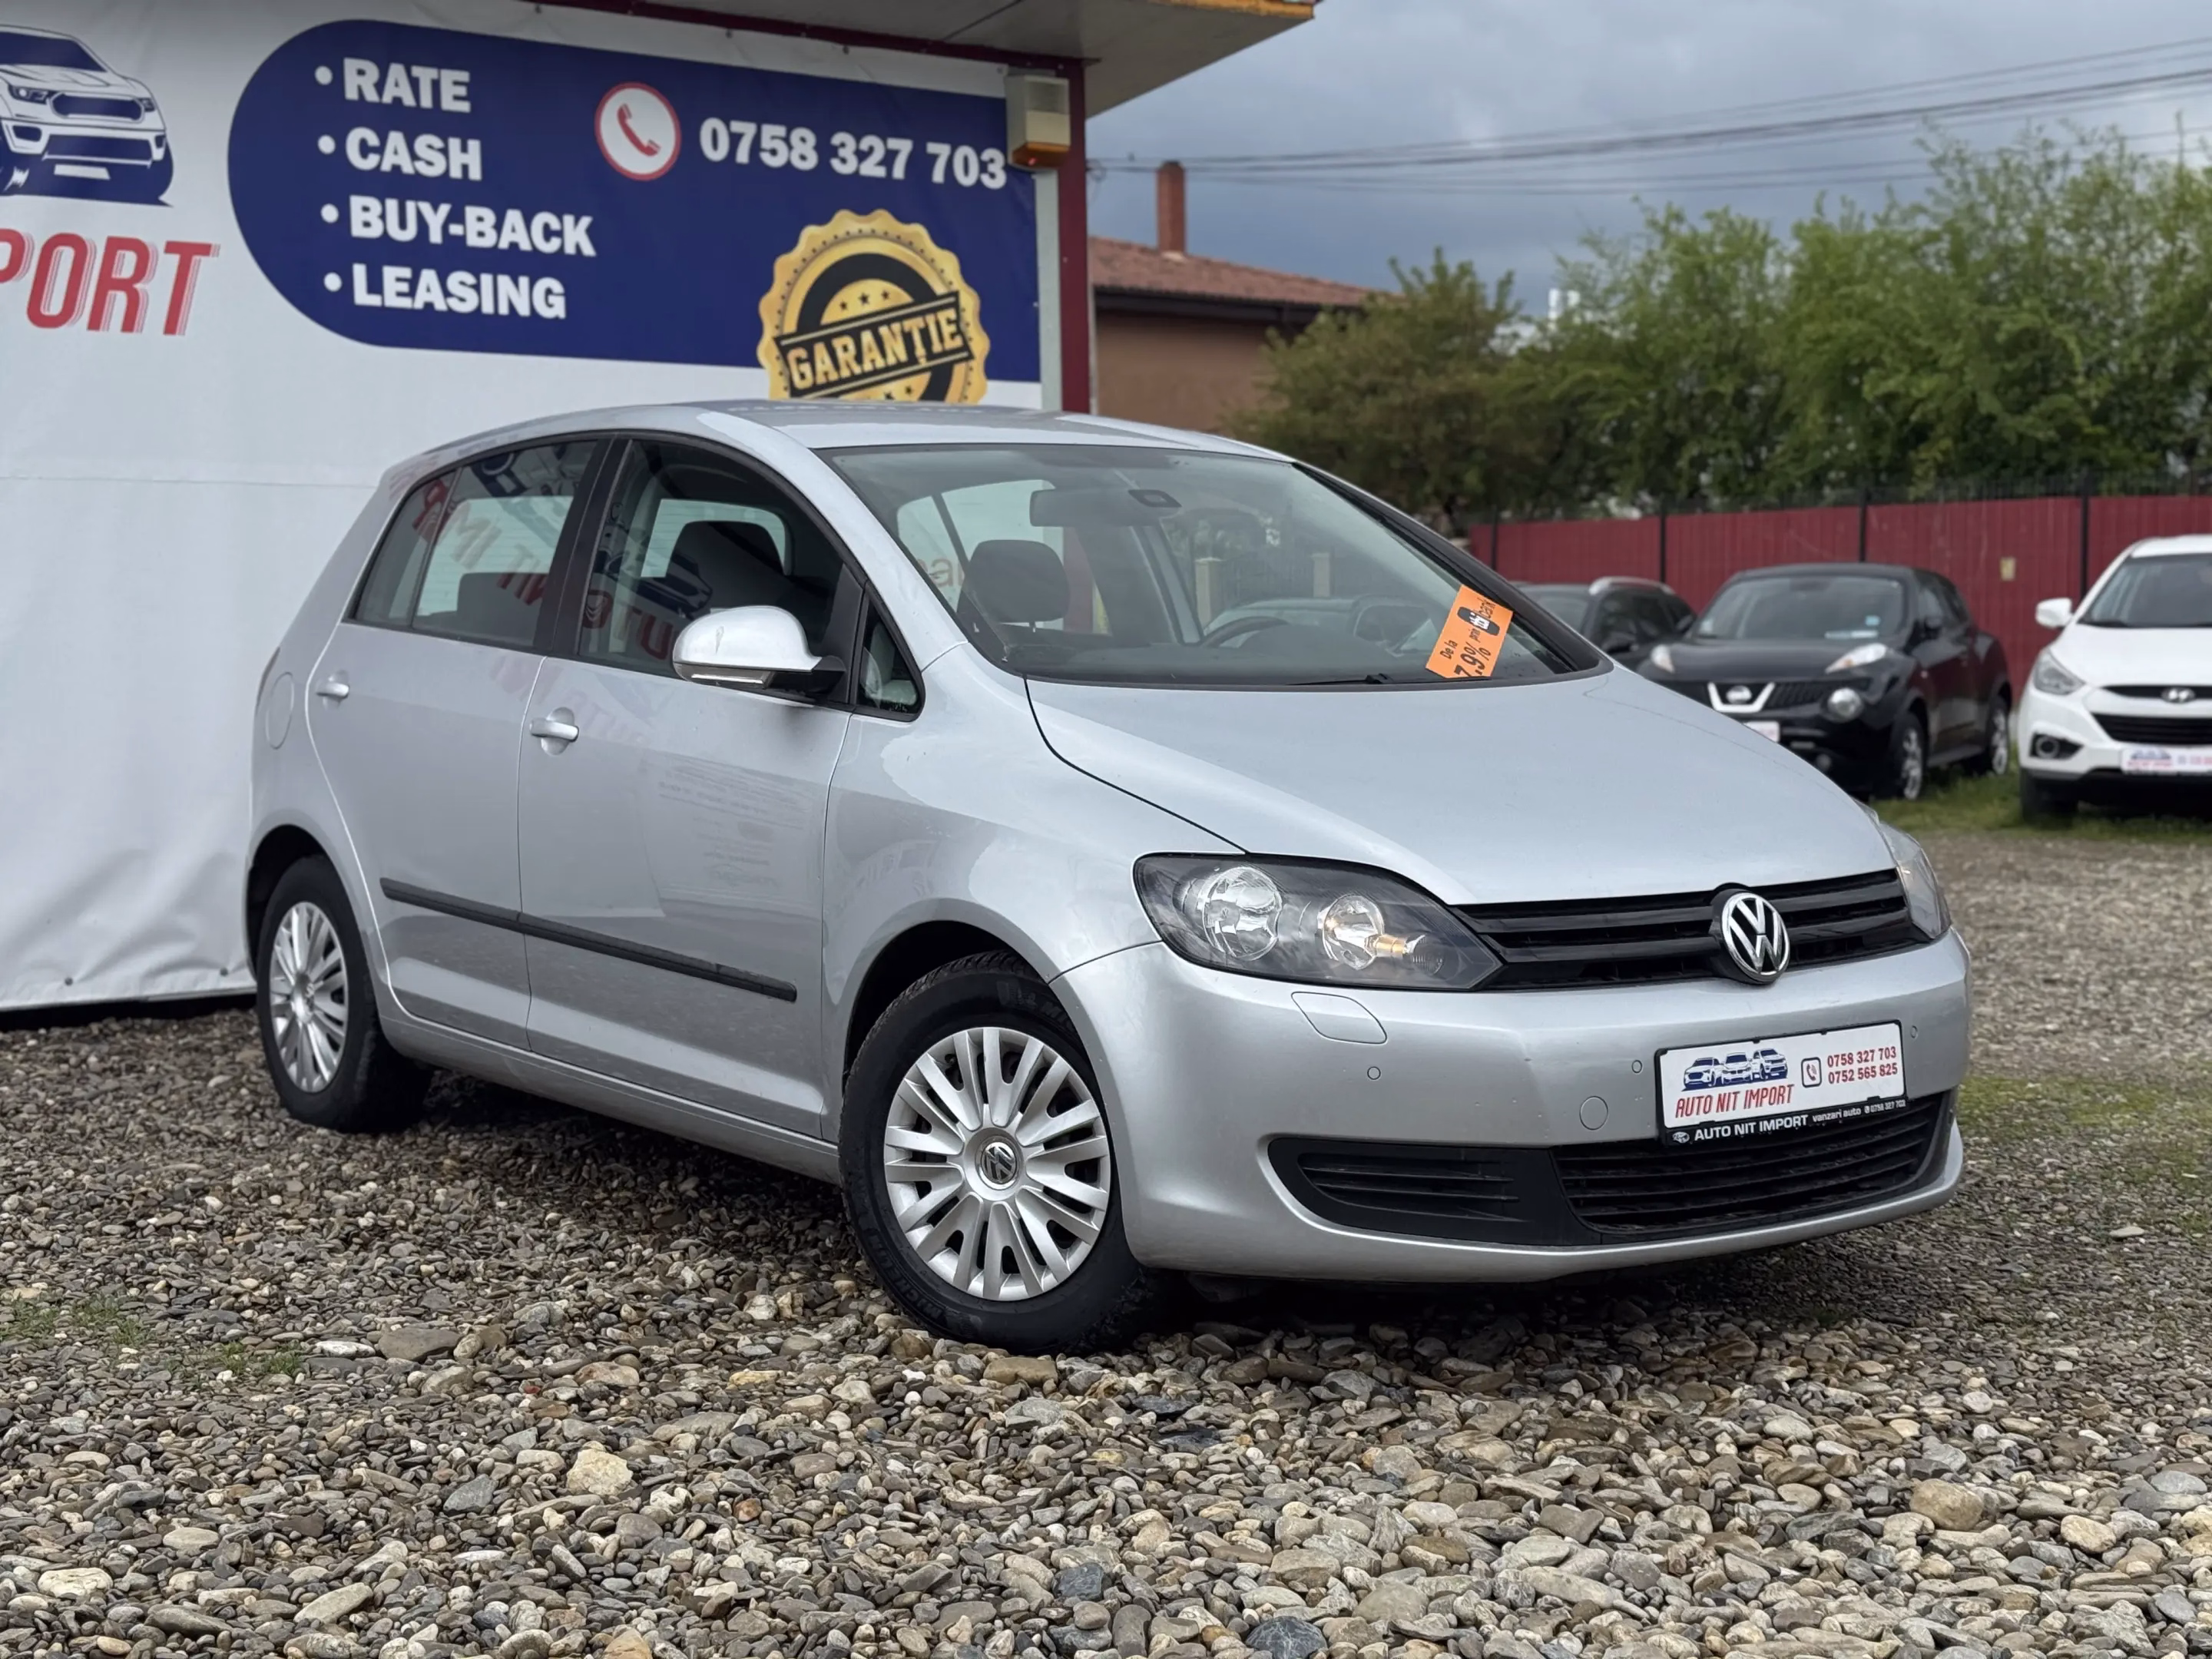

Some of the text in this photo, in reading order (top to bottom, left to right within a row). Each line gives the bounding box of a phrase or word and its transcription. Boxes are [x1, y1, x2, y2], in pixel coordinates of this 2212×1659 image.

[344, 58, 471, 113] RATE
[346, 127, 482, 180] CASH
[700, 118, 1007, 190] 0758 327 703
[349, 195, 597, 257] BUY-BACK
[353, 263, 567, 320] LEASING
[1439, 640, 1458, 660] De la
[1827, 1046, 1896, 1068] 0758 327 703
[1828, 1069, 1855, 1084] 0752
[1858, 1066, 1876, 1080] 565
[1675, 1084, 1794, 1118] AUTO NIT IMPORT
[1694, 1126, 1731, 1141] AUTO
[1734, 1122, 1757, 1136] NIT
[1759, 1114, 1808, 1131] IMPORT
[1813, 1109, 1843, 1122] vanzari
[1843, 1108, 1861, 1118] auto
